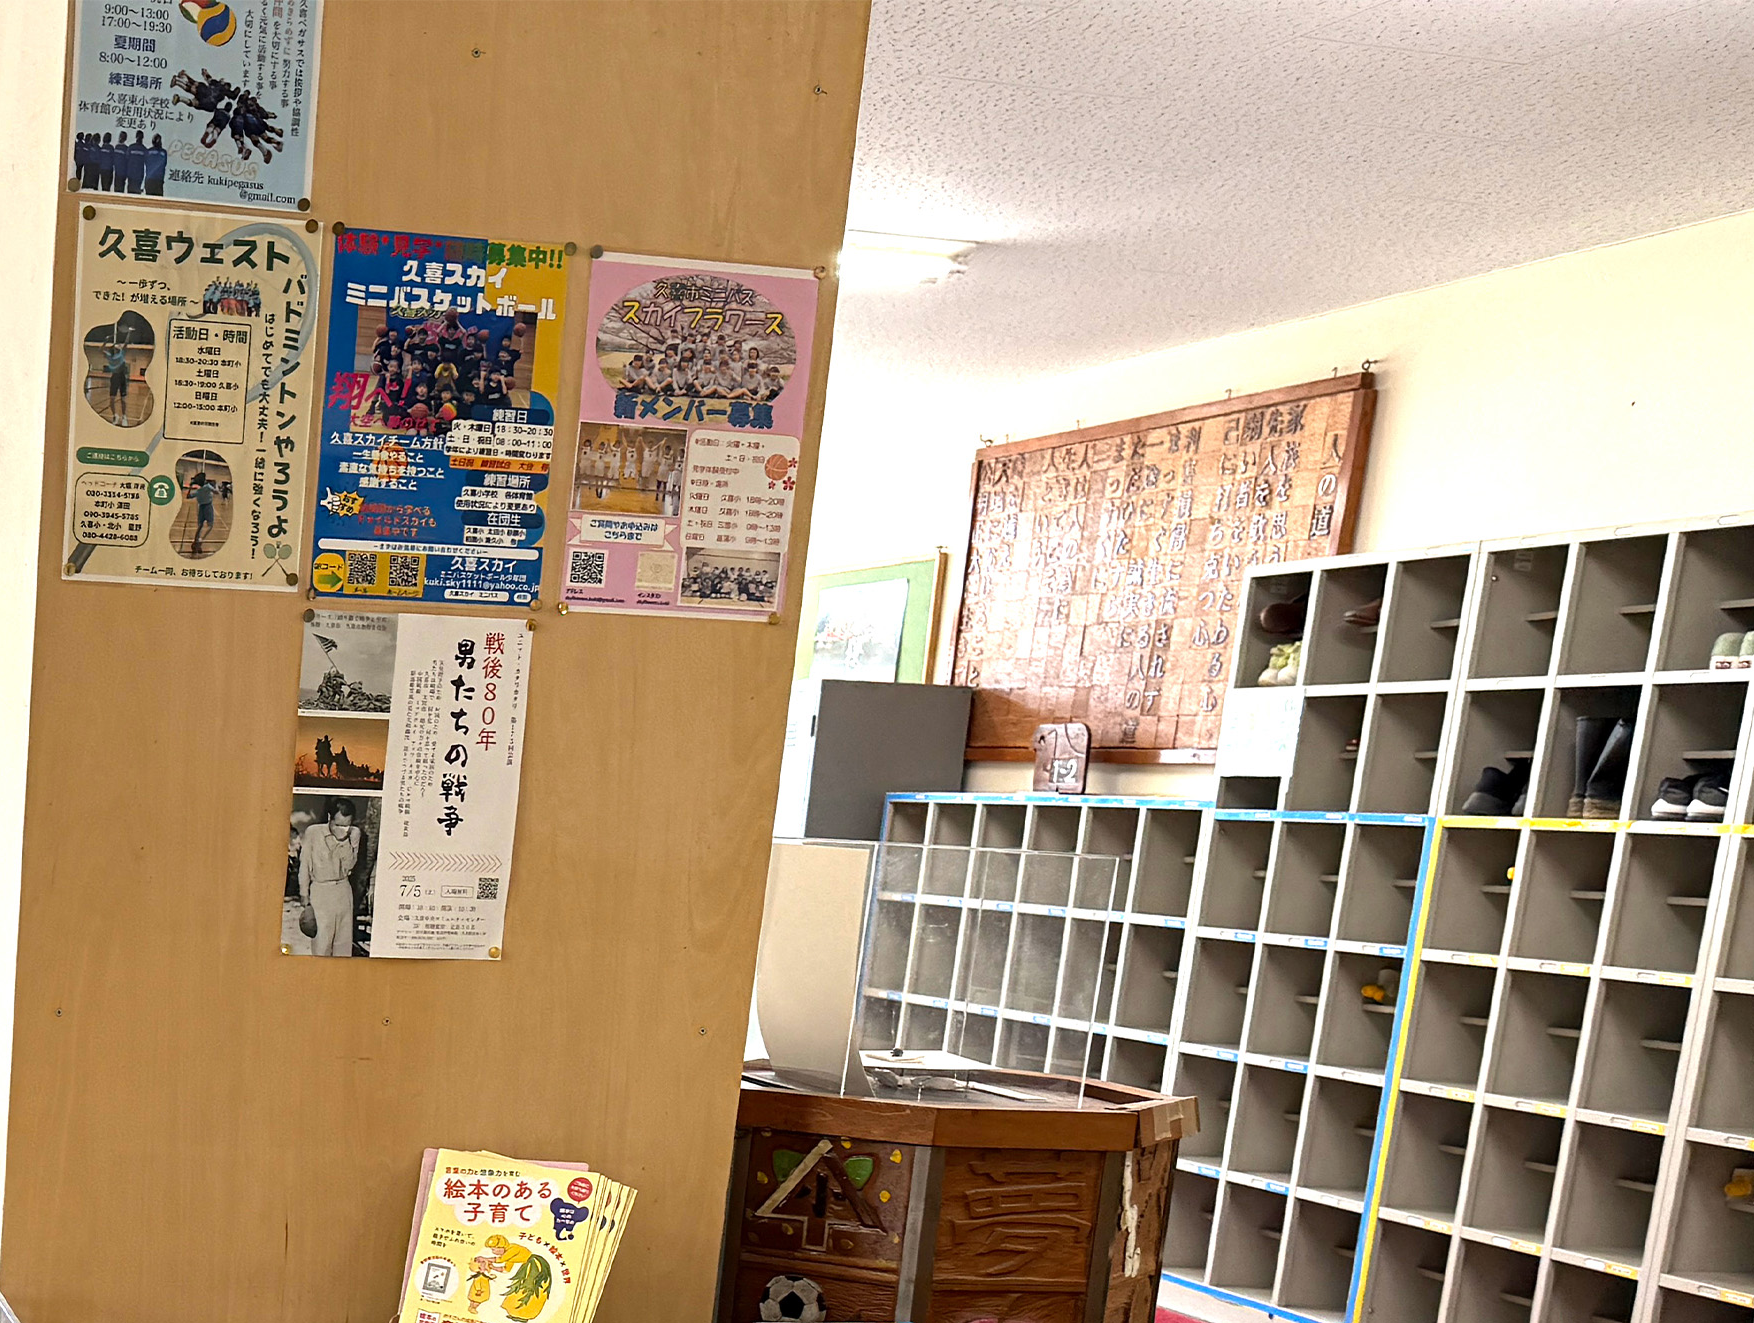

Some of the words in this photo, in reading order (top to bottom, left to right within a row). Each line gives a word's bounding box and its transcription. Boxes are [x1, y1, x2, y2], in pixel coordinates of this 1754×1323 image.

[114, 34, 156, 53] 夏期間
[108, 72, 163, 91] 練習場所
[115, 116, 157, 131] 変更あり
[168, 168, 205, 185] 連絡先
[239, 189, 296, 205] @gmail.com
[98, 225, 291, 272] 久喜ウェスト
[402, 260, 508, 289] 久喜スカイ
[345, 282, 557, 321] ミニバスケットボール
[172, 325, 248, 344] 活動日・時間
[196, 368, 219, 378] 土曜日
[195, 391, 218, 401] 日曜日
[267, 274, 308, 538] バドミントンやろうよ
[613, 391, 774, 430] 新メンバー募集
[330, 431, 444, 451] 久喜スカイチーム方針
[483, 473, 531, 489] 練習場所
[1310, 431, 1345, 537] 人の道
[450, 556, 518, 574] 久喜スカイ
[476, 632, 506, 752] 戦後80年
[437, 638, 476, 836] 男たちの戦争
[399, 884, 421, 898] 7/5
[443, 1177, 552, 1200] 絵本のある
[463, 1202, 534, 1223] 子育て
